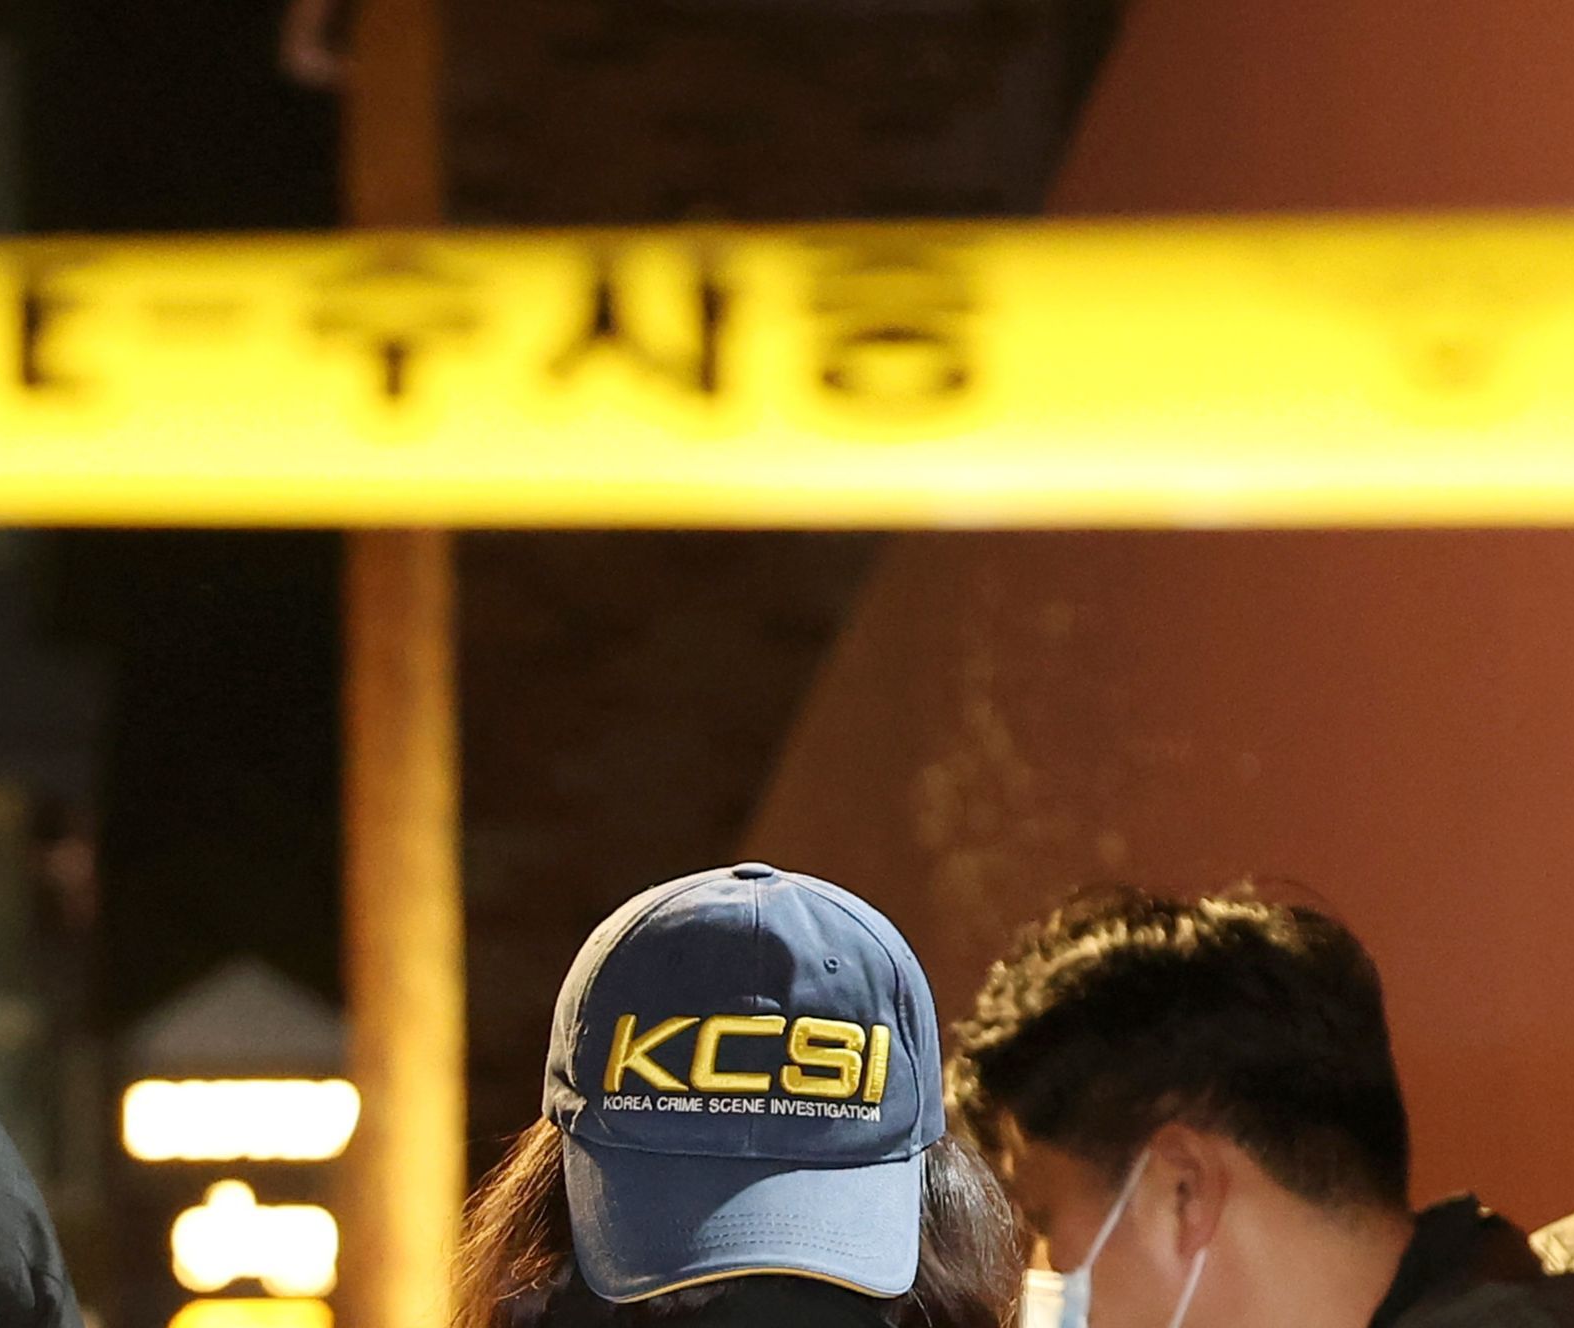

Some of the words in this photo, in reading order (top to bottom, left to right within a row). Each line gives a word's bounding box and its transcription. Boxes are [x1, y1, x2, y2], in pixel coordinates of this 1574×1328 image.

[603, 1014, 890, 1103] KCSI
[603, 1095, 652, 1111] KOREA
[656, 1096, 703, 1112] CRIME
[708, 1097, 765, 1113] SCENE
[770, 1098, 880, 1122] INVESTIGATION
